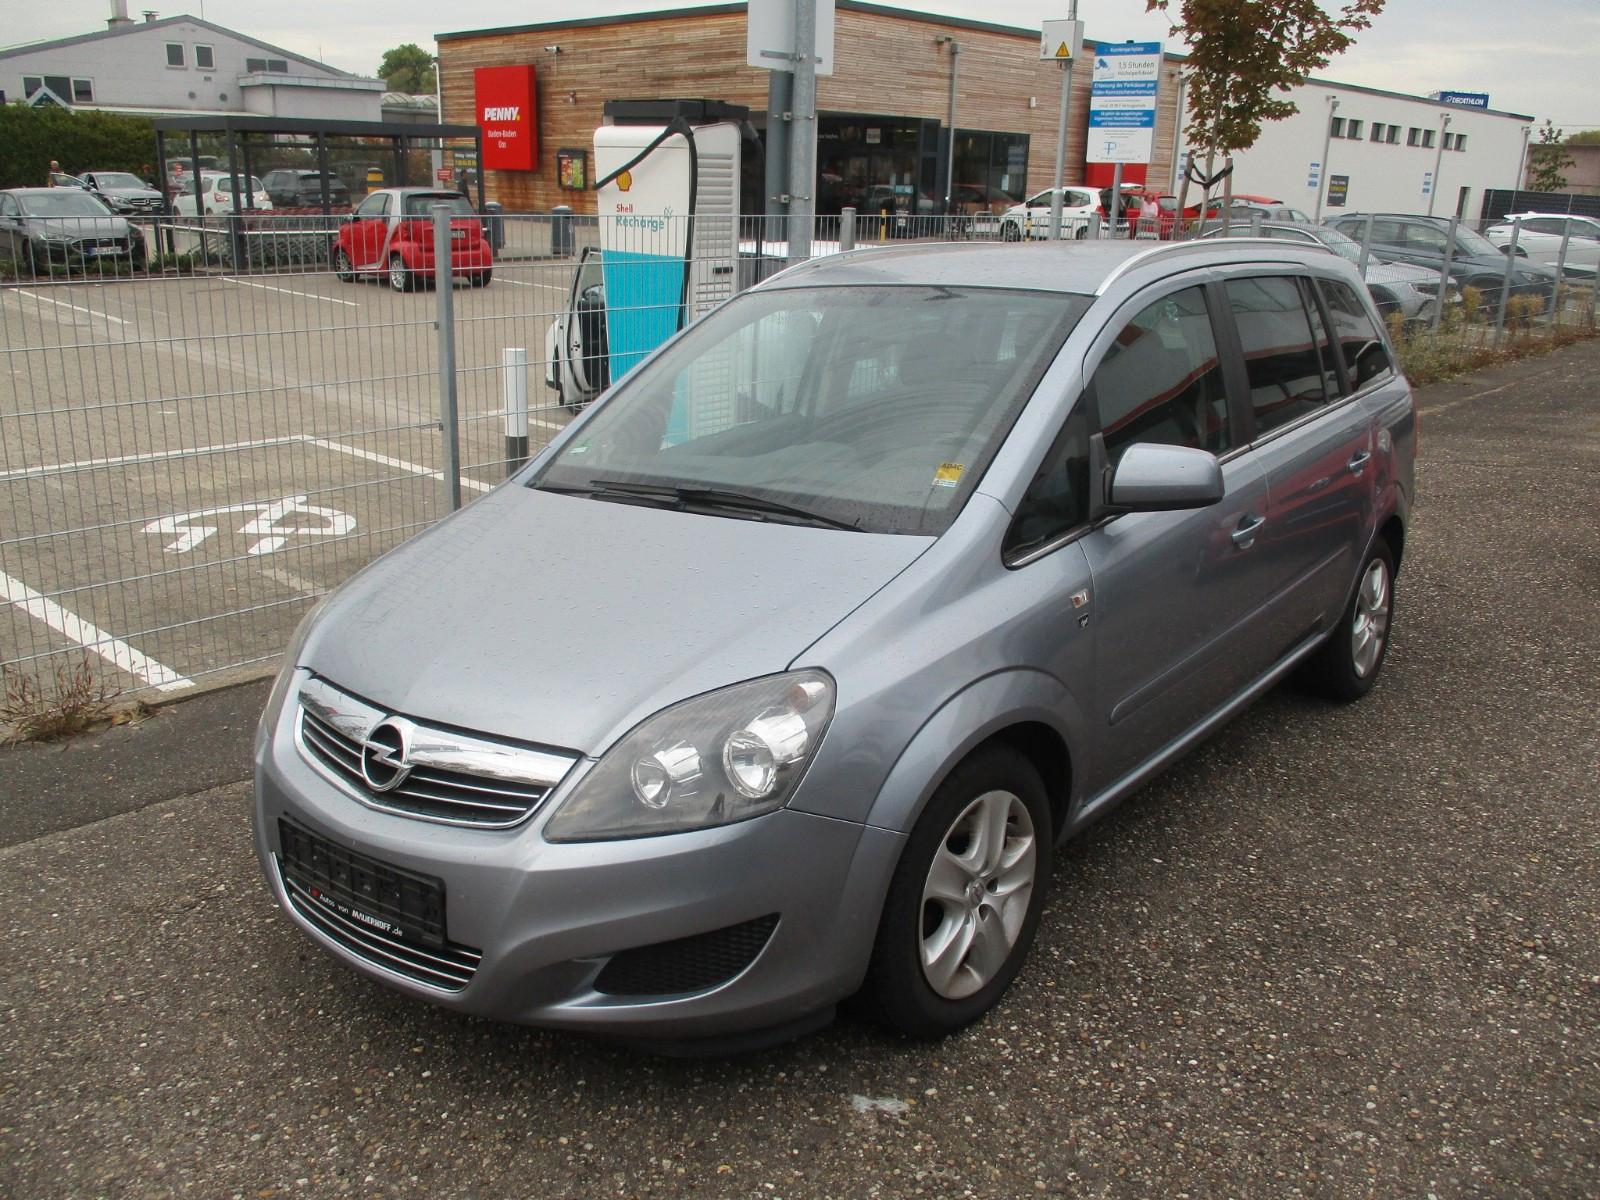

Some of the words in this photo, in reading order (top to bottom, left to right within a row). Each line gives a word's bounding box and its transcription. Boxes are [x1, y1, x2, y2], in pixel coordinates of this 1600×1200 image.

[1128, 61, 1155, 69] Stunden
[1452, 96, 1484, 106] DECATHLON
[488, 130, 517, 138] Baden-Baden
[616, 203, 633, 213] Shell
[616, 215, 665, 232] Recharge
[942, 463, 964, 471] ADAC
[338, 906, 349, 915] von
